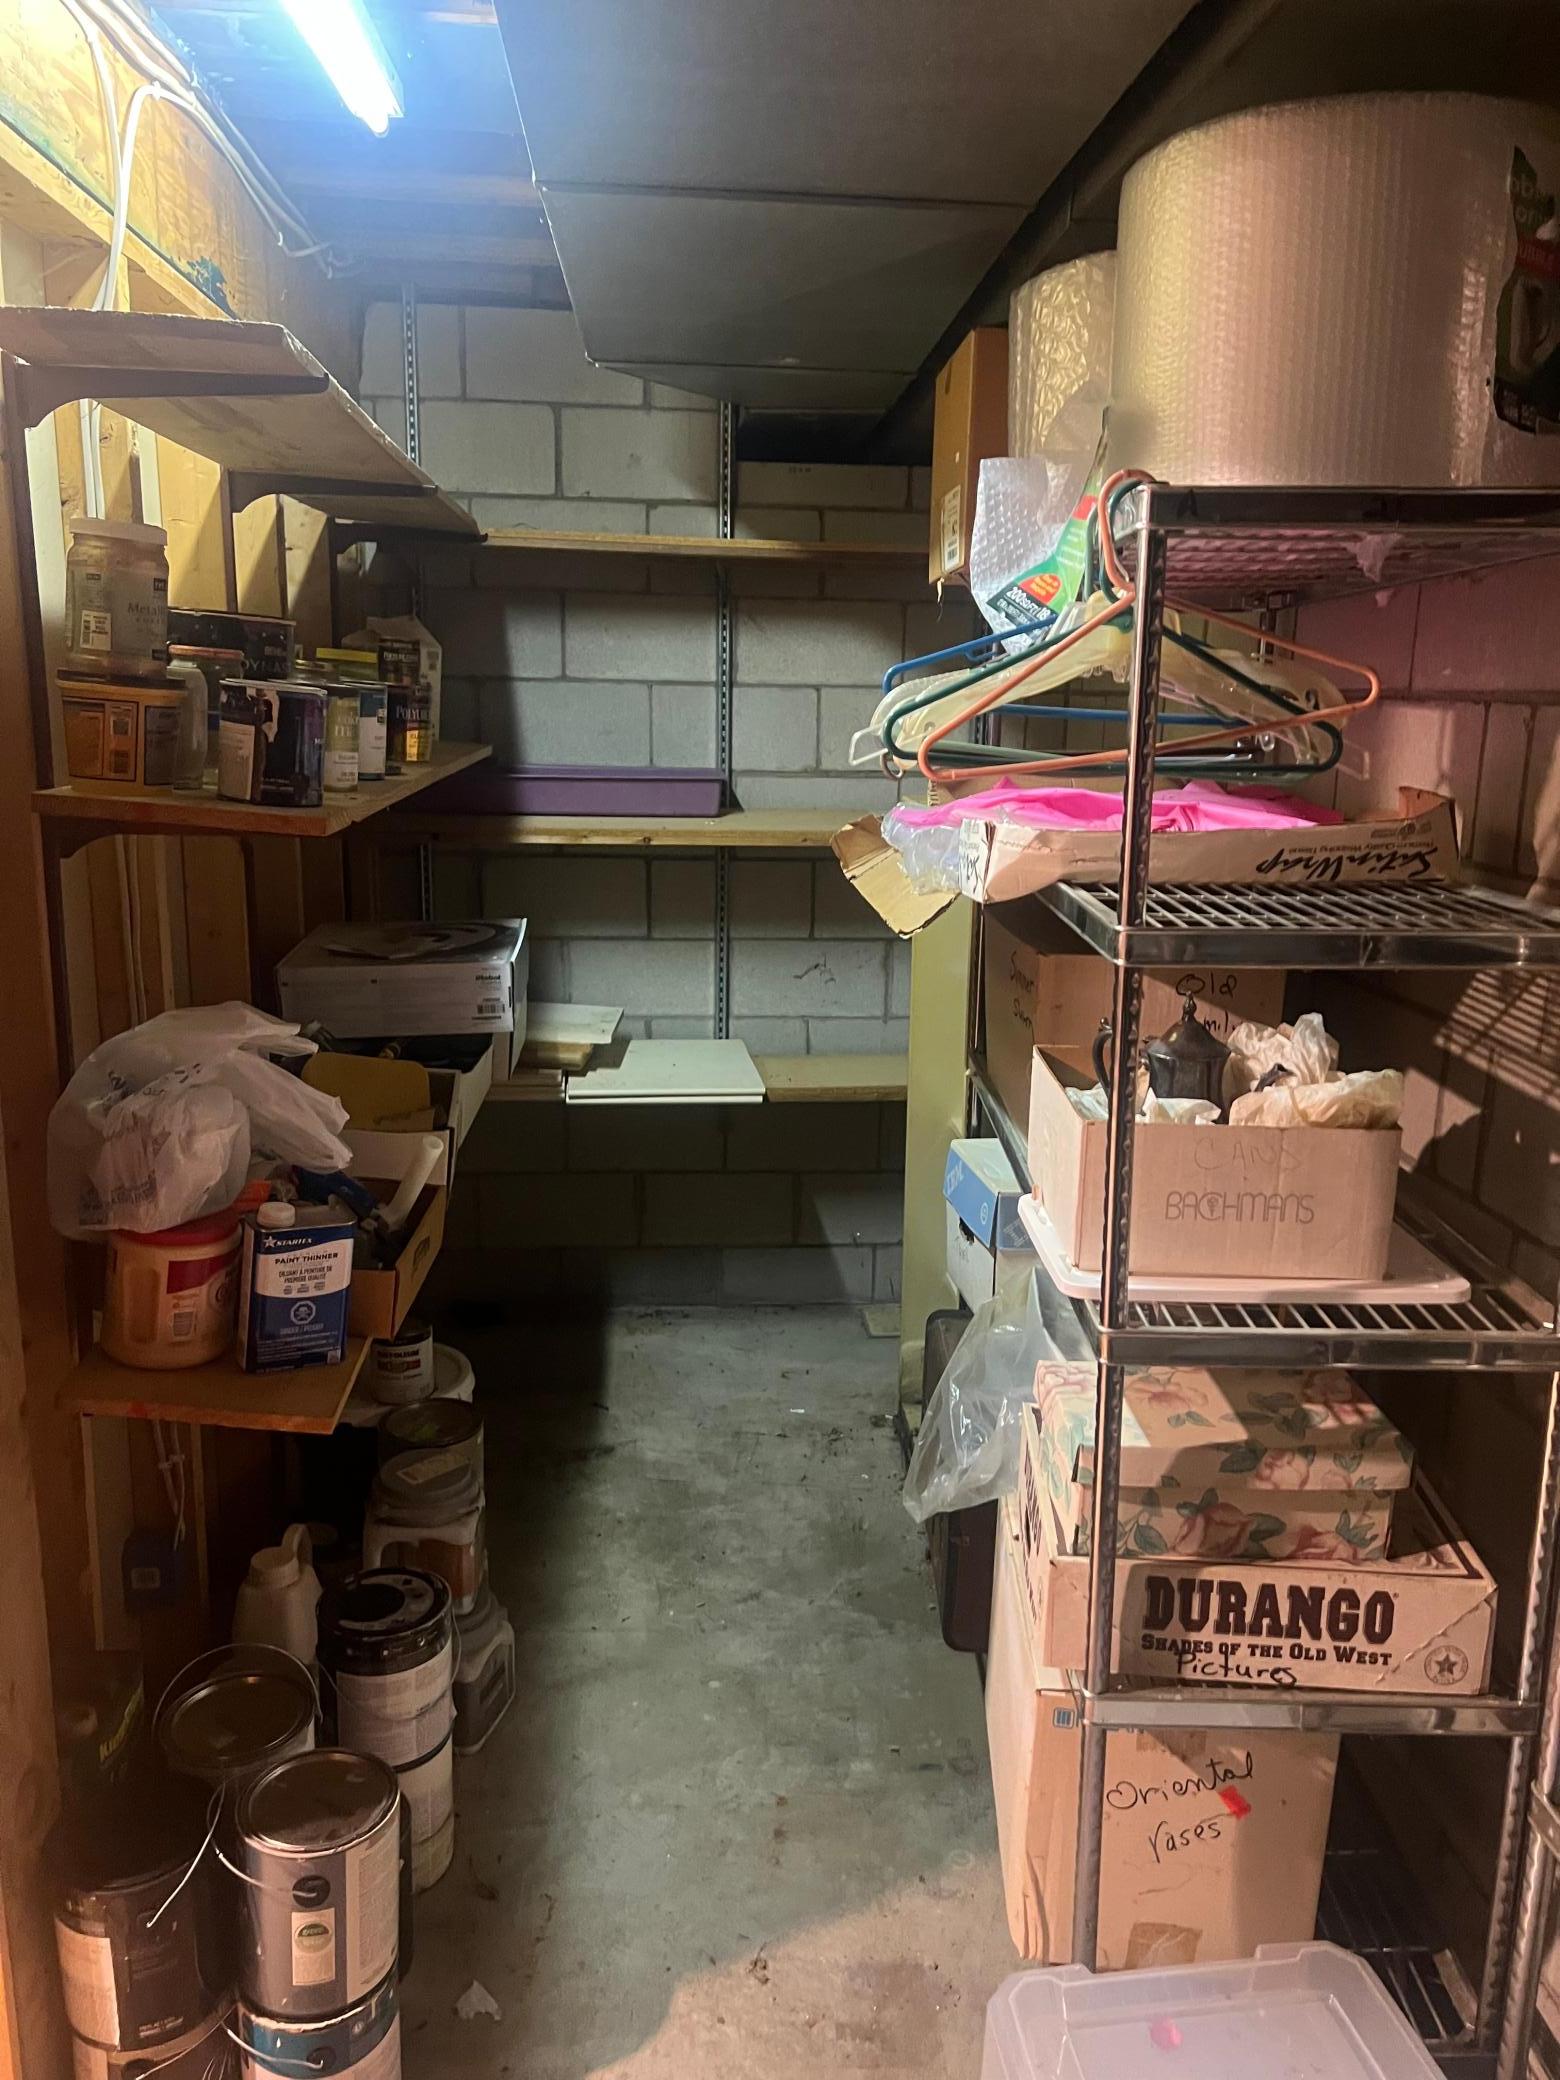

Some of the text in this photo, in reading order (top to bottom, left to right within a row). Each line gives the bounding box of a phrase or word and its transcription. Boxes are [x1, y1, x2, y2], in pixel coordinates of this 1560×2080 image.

[1176, 973, 1238, 997] Old
[1165, 1191, 1315, 1224] BACHMANS
[275, 1252, 338, 1265] PAINT THINNER
[1142, 1575, 1395, 1645] DURANGO
[1106, 1751, 1254, 1810] Oriental
[1149, 1820, 1222, 1864] Vases
